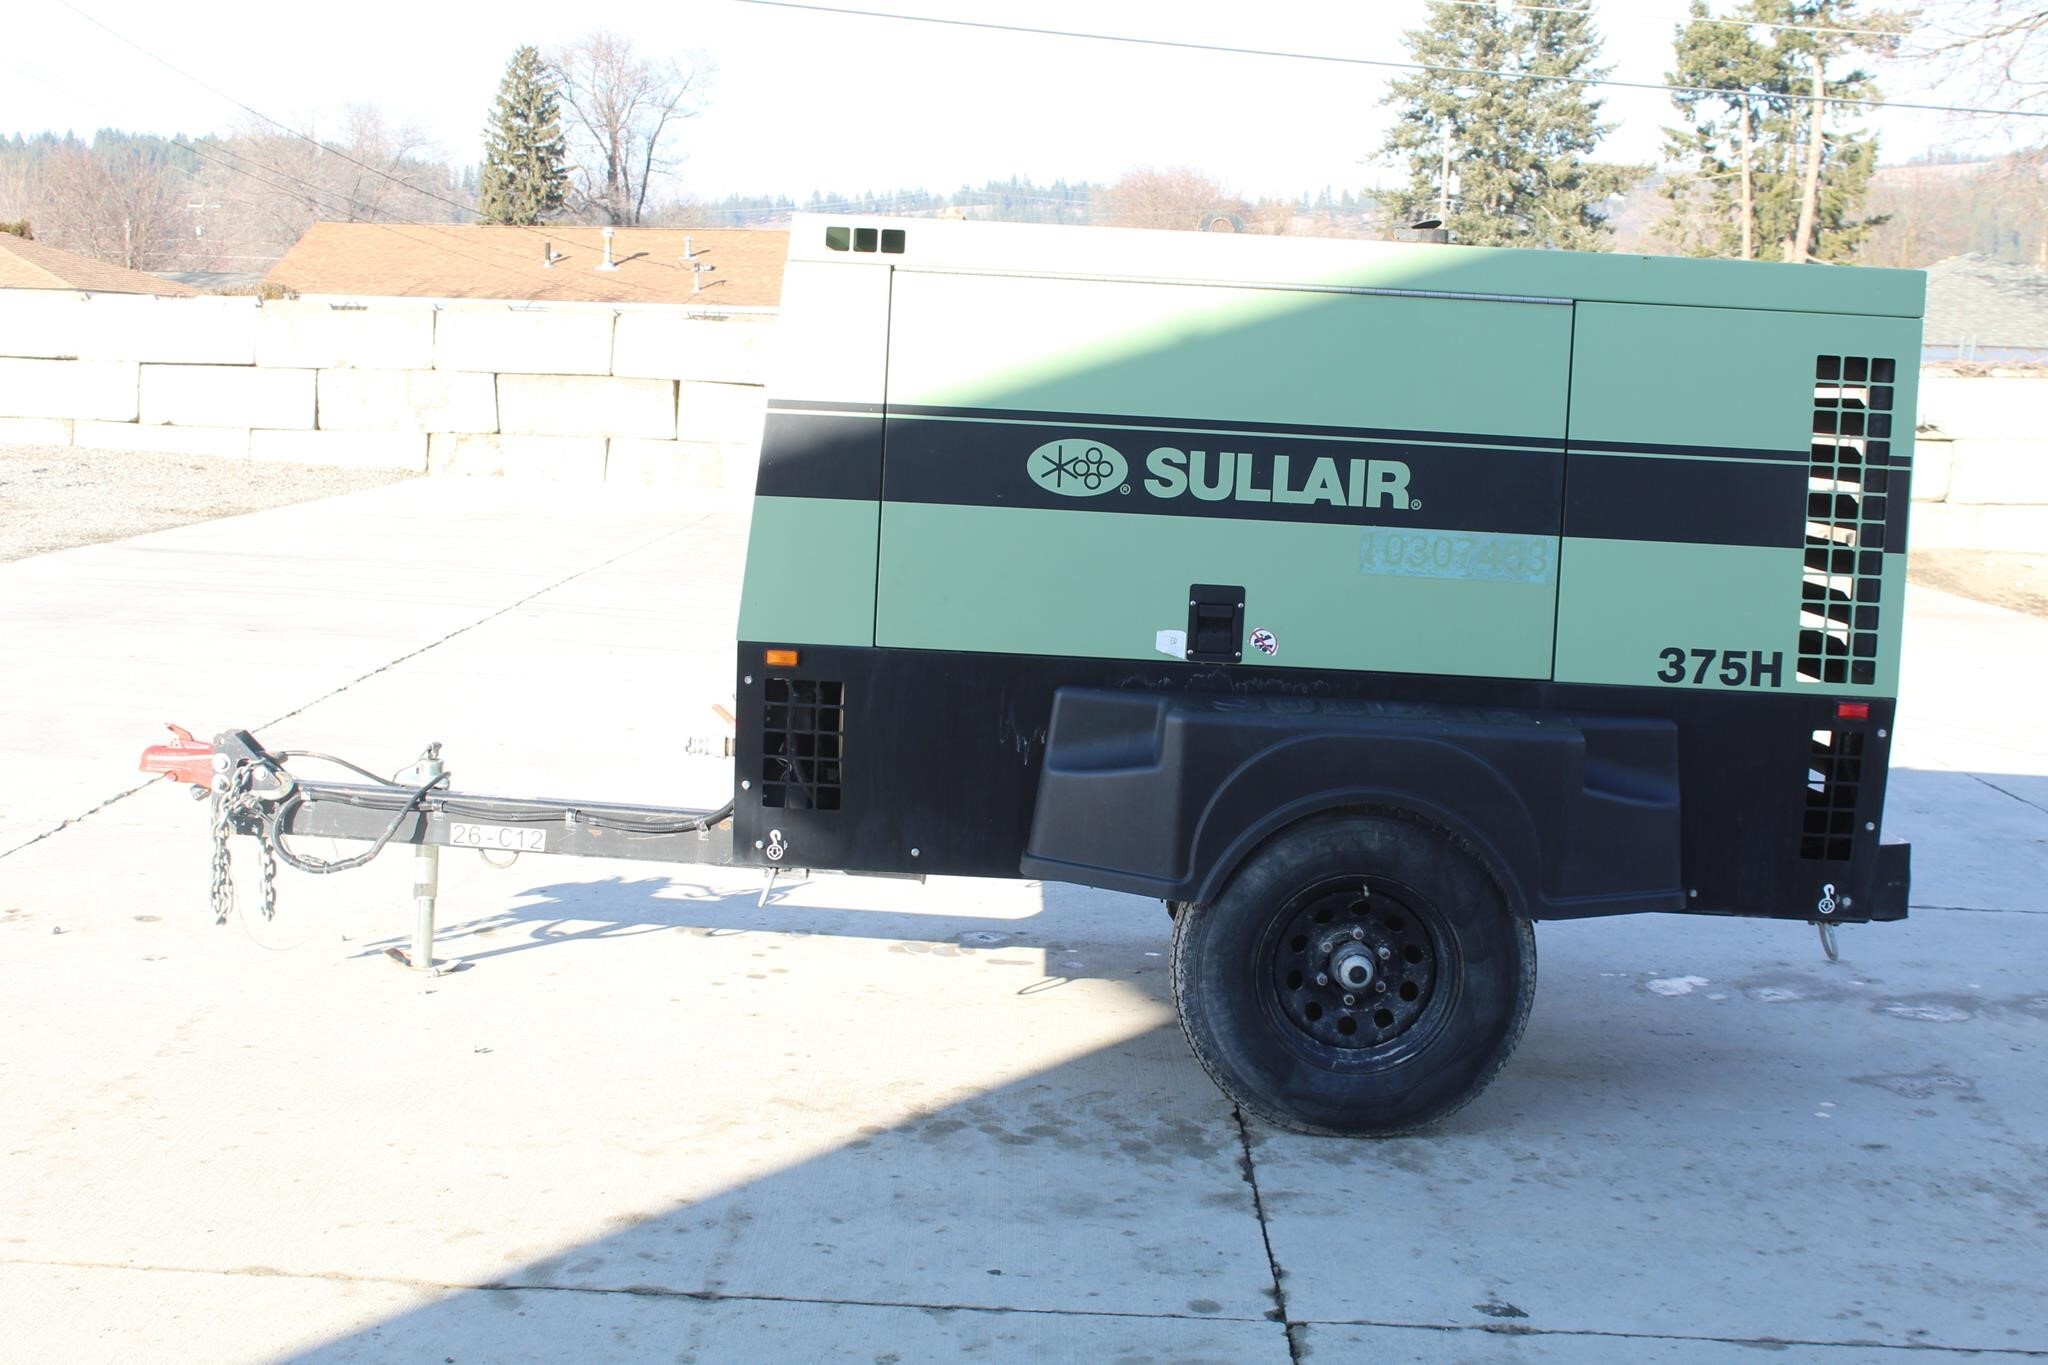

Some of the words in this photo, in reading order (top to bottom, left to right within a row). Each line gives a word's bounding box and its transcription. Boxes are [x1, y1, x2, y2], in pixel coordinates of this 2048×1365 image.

[1144, 446, 1410, 510] SULLAIR
[1656, 647, 1783, 688] 375H
[453, 824, 543, 850] 26-C12
